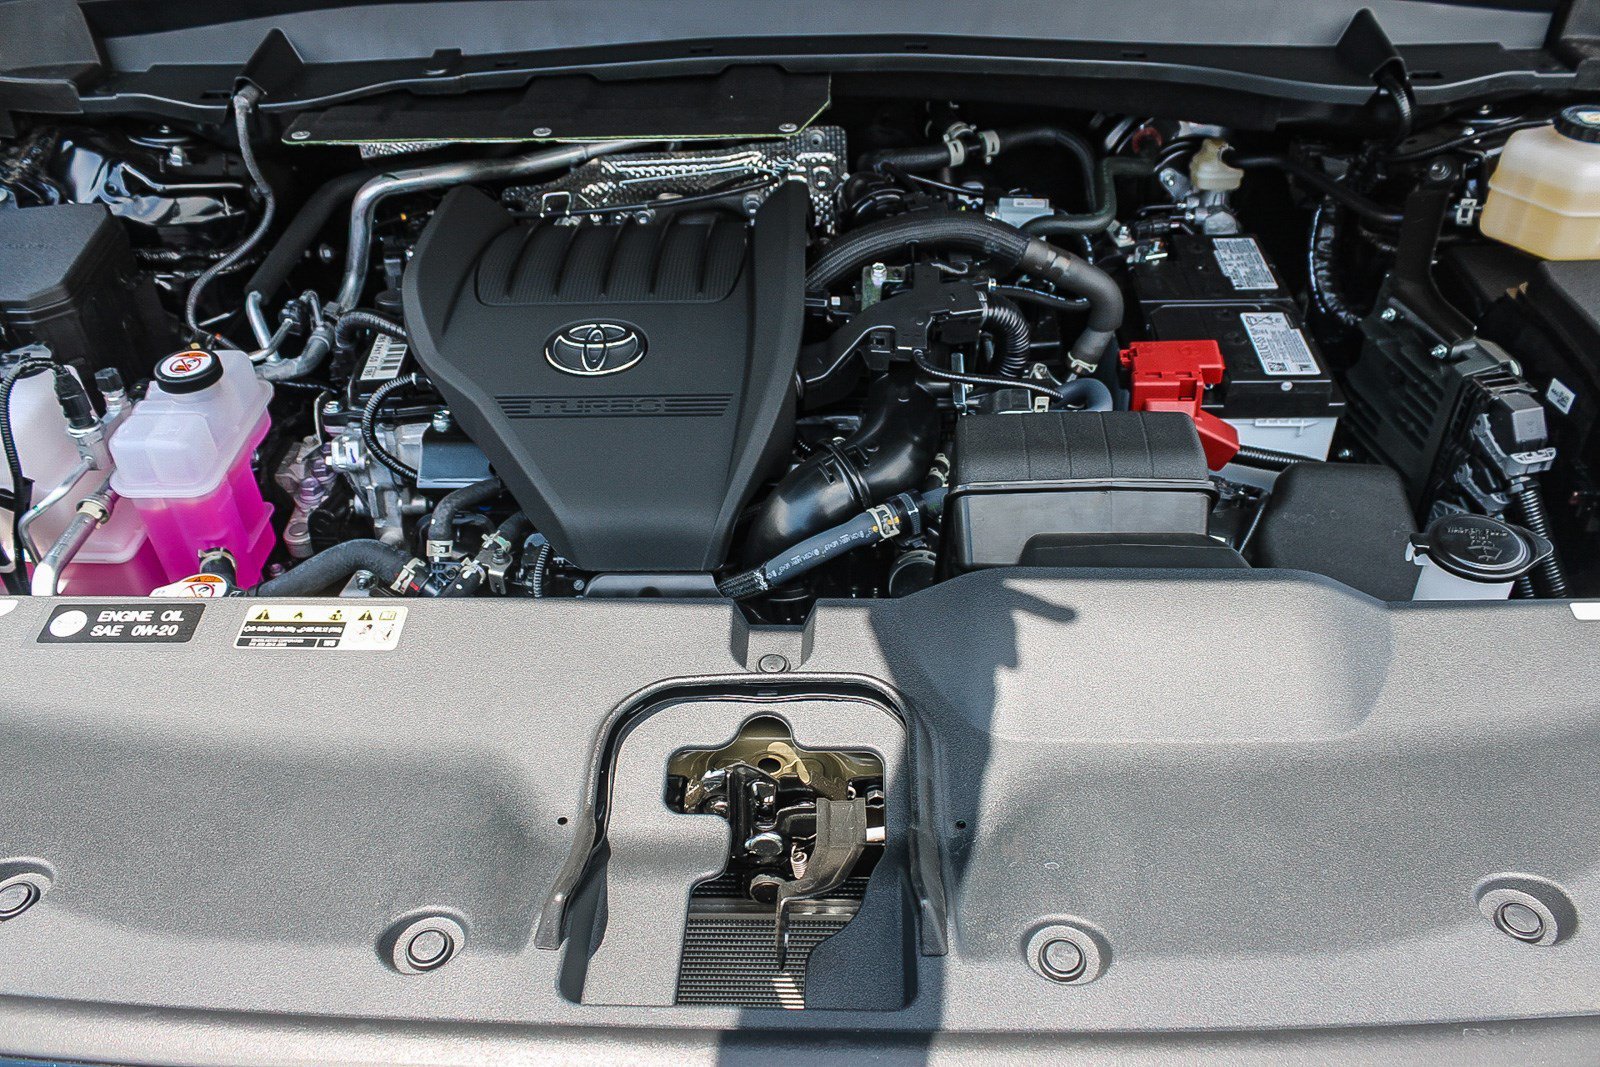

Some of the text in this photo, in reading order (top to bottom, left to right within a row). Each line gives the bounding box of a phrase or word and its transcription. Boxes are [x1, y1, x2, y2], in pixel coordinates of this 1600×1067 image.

[531, 399, 665, 414] TURBO
[97, 610, 185, 623] ENGINE OIL
[90, 624, 179, 637] SAE 0W-20
